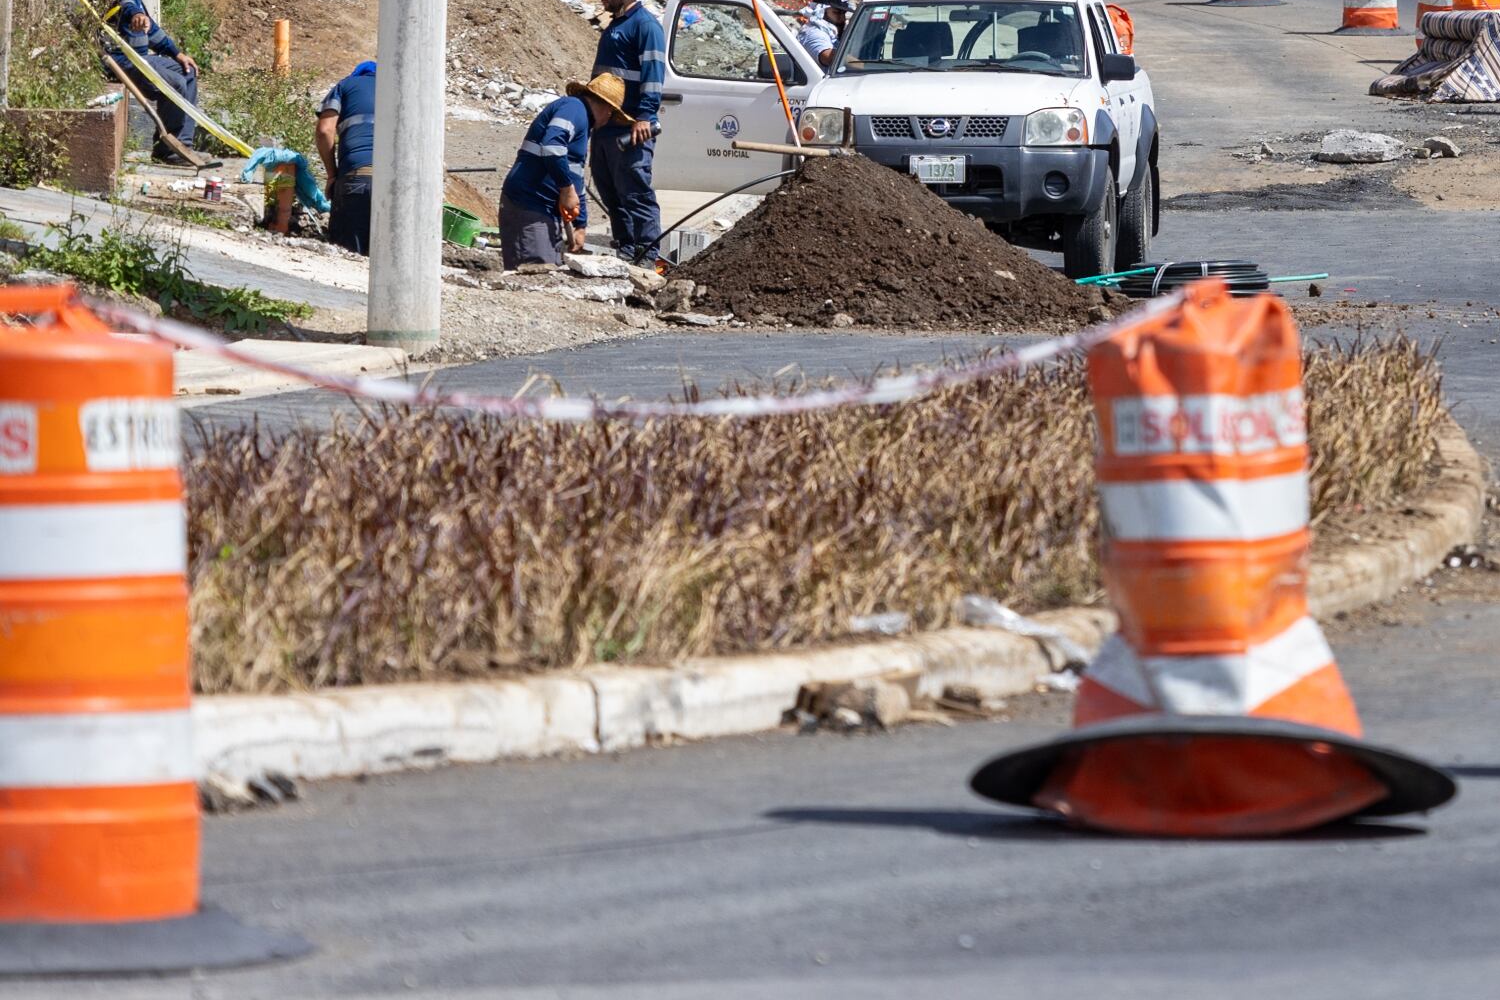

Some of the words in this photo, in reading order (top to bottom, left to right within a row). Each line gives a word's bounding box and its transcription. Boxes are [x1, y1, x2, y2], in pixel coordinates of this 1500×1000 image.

[707, 148, 721, 157] USO
[723, 150, 750, 159] OFICIAL
[928, 163, 955, 177] 1373
